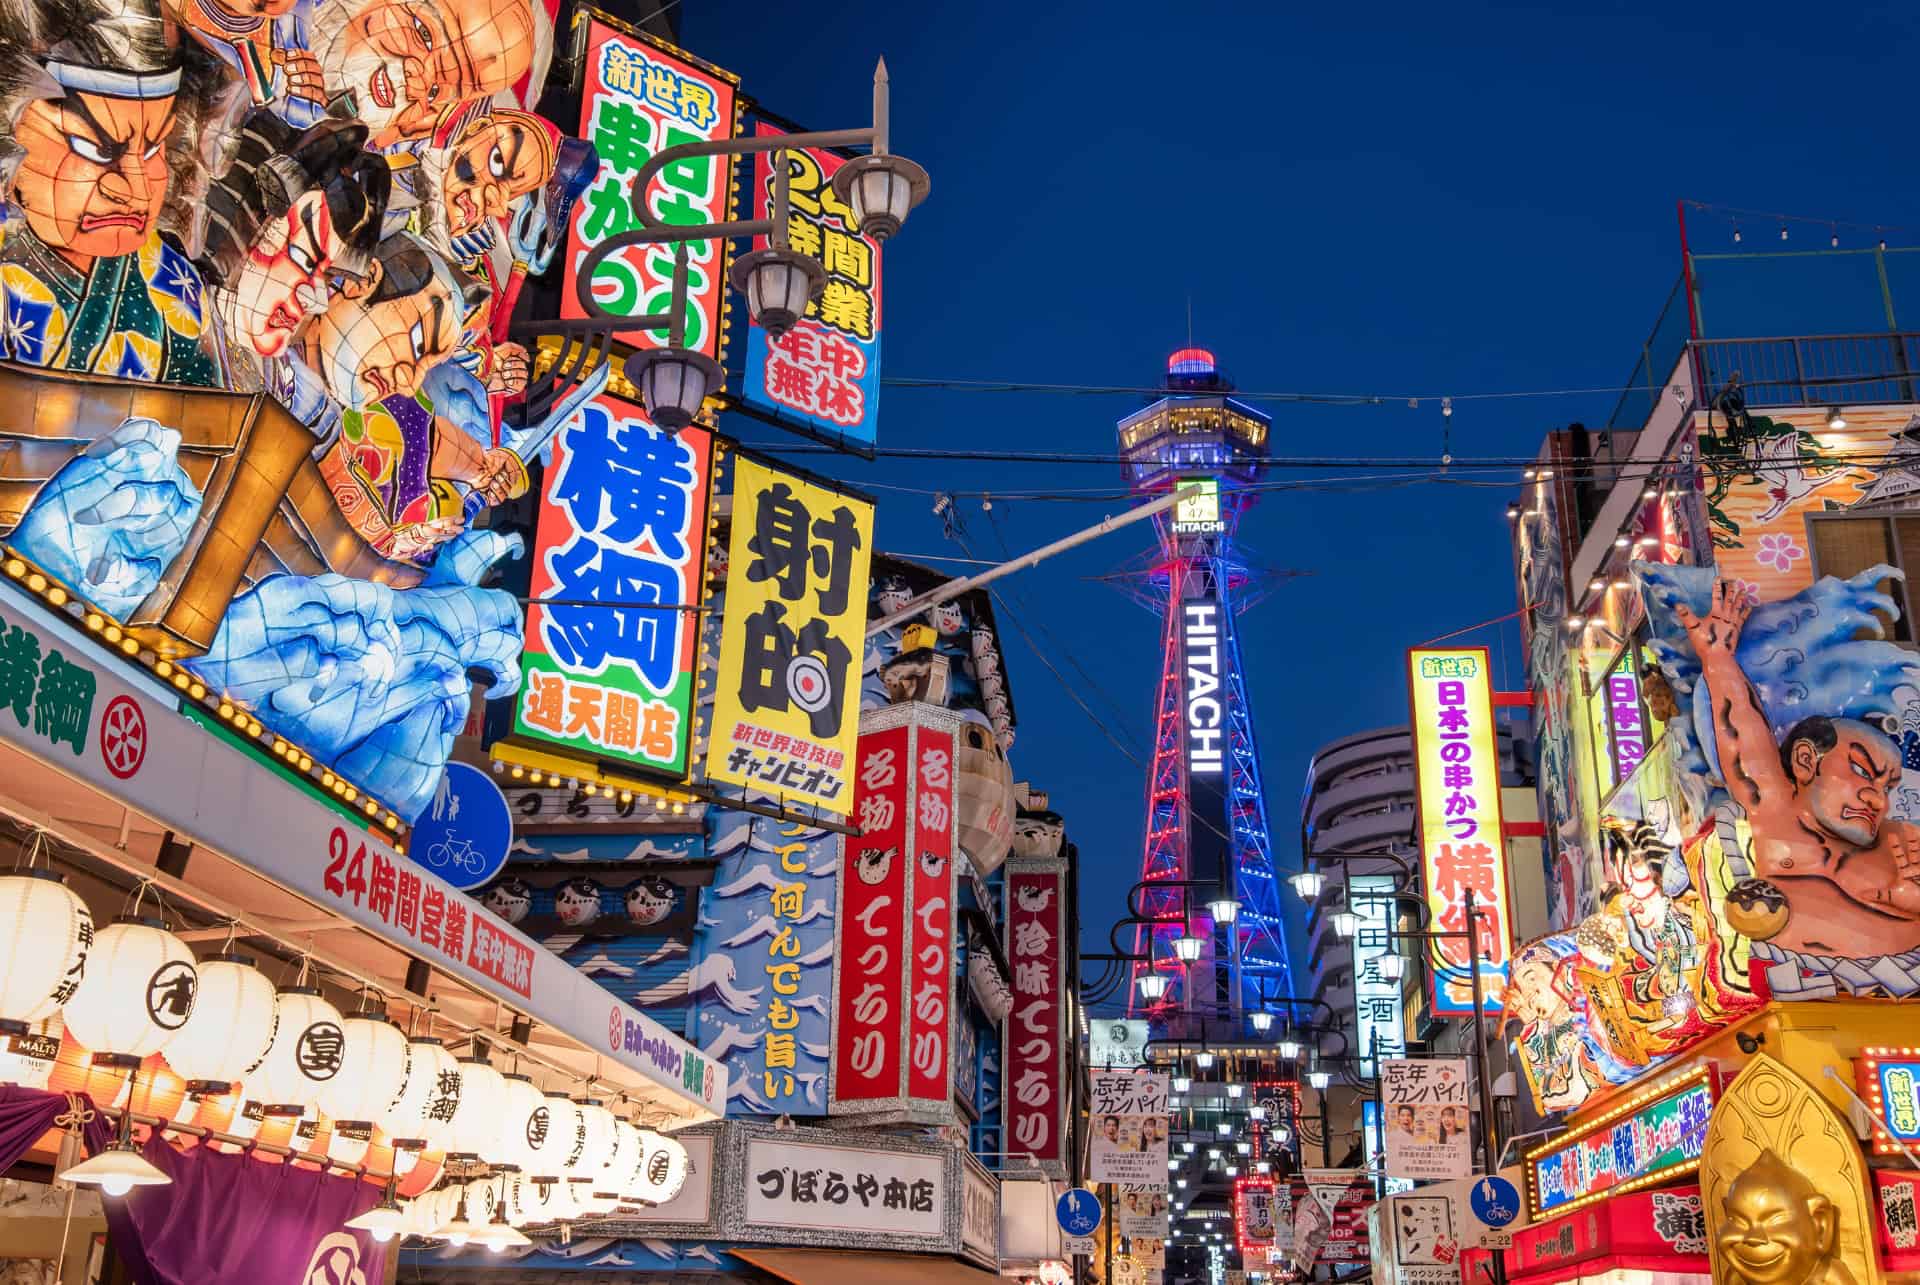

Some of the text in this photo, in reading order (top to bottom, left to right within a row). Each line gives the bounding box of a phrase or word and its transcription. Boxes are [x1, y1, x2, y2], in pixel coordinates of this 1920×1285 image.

[604, 44, 717, 129] 新世界
[584, 103, 651, 315] 串かつ
[766, 359, 864, 424] 無休
[547, 402, 696, 694] 横綱
[1171, 521, 1225, 533] HITACHI
[738, 484, 861, 739] 射的
[1186, 605, 1223, 773] HITACHI
[1421, 657, 1477, 679] 新世界
[527, 669, 679, 762] 通天閣店
[733, 722, 845, 770] 新世界遊技場
[727, 747, 846, 800] チャンピオン
[1438, 681, 1479, 840] 日本一の串かつ
[323, 826, 530, 992] 24時間営業 年中無休
[850, 747, 905, 1079] 名物 てっちり
[913, 747, 951, 1080] 名物 てっちり
[1433, 842, 1500, 966] 横綱
[1014, 921, 1052, 1151] 珍味てっちり
[1384, 1063, 1429, 1084] 忘年
[1093, 1077, 1135, 1097] 忘年
[1097, 1095, 1167, 1114] カンパイ!
[1390, 1081, 1466, 1103] カンパイ!
[1889, 1071, 1917, 1131] 新世界
[756, 1167, 936, 1213] づぼらや本店
